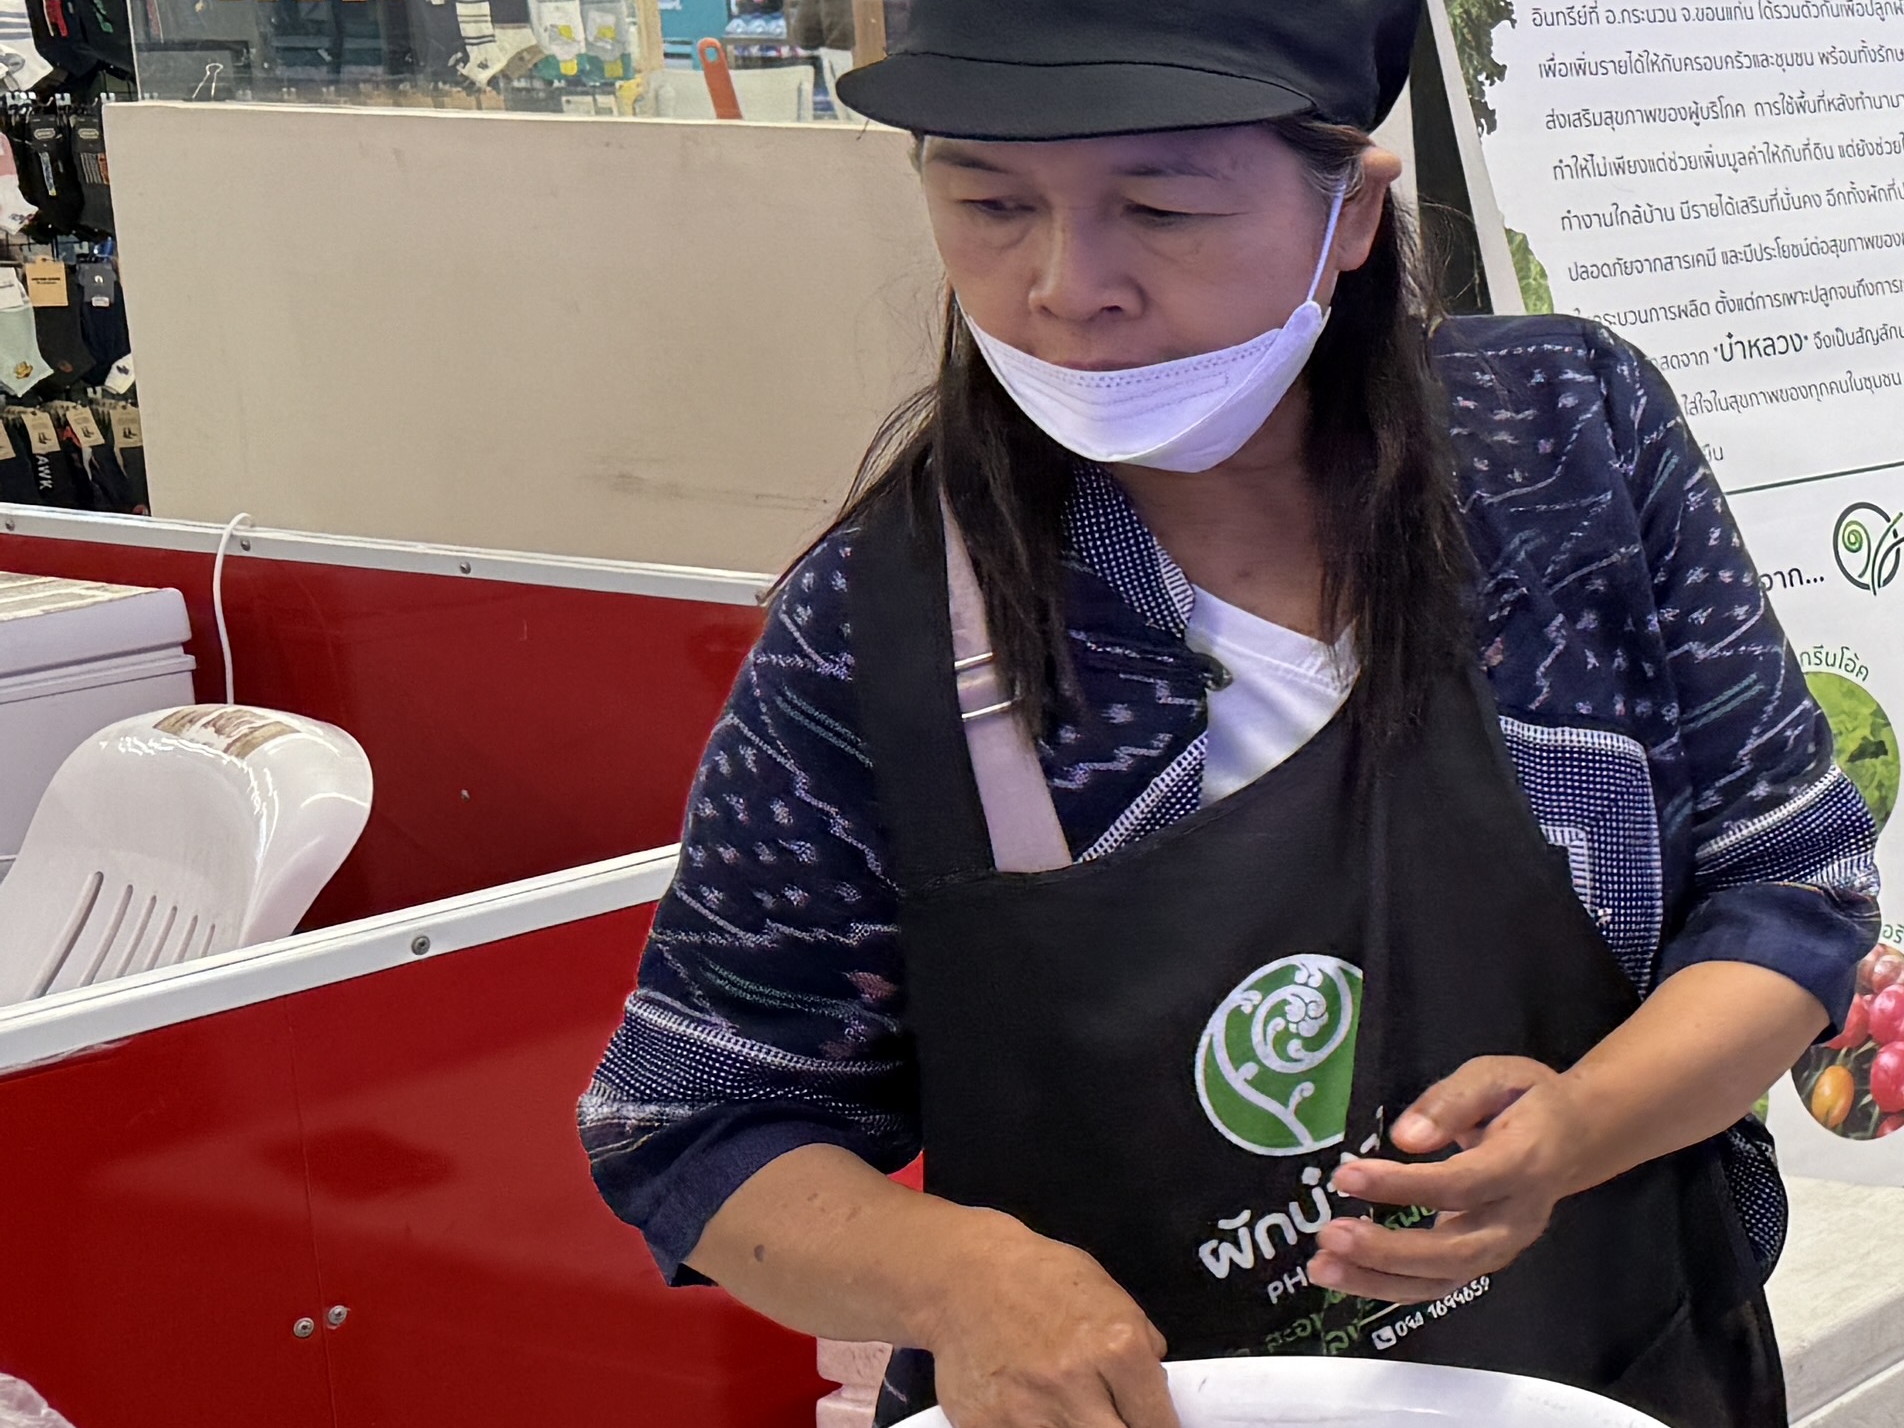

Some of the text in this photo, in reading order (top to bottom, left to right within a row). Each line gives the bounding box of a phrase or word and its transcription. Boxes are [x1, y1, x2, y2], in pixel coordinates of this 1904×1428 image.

[1606, 6, 1677, 25] อ.กระนวน
[1681, 1, 1753, 23] จ.ขอนแก่น
